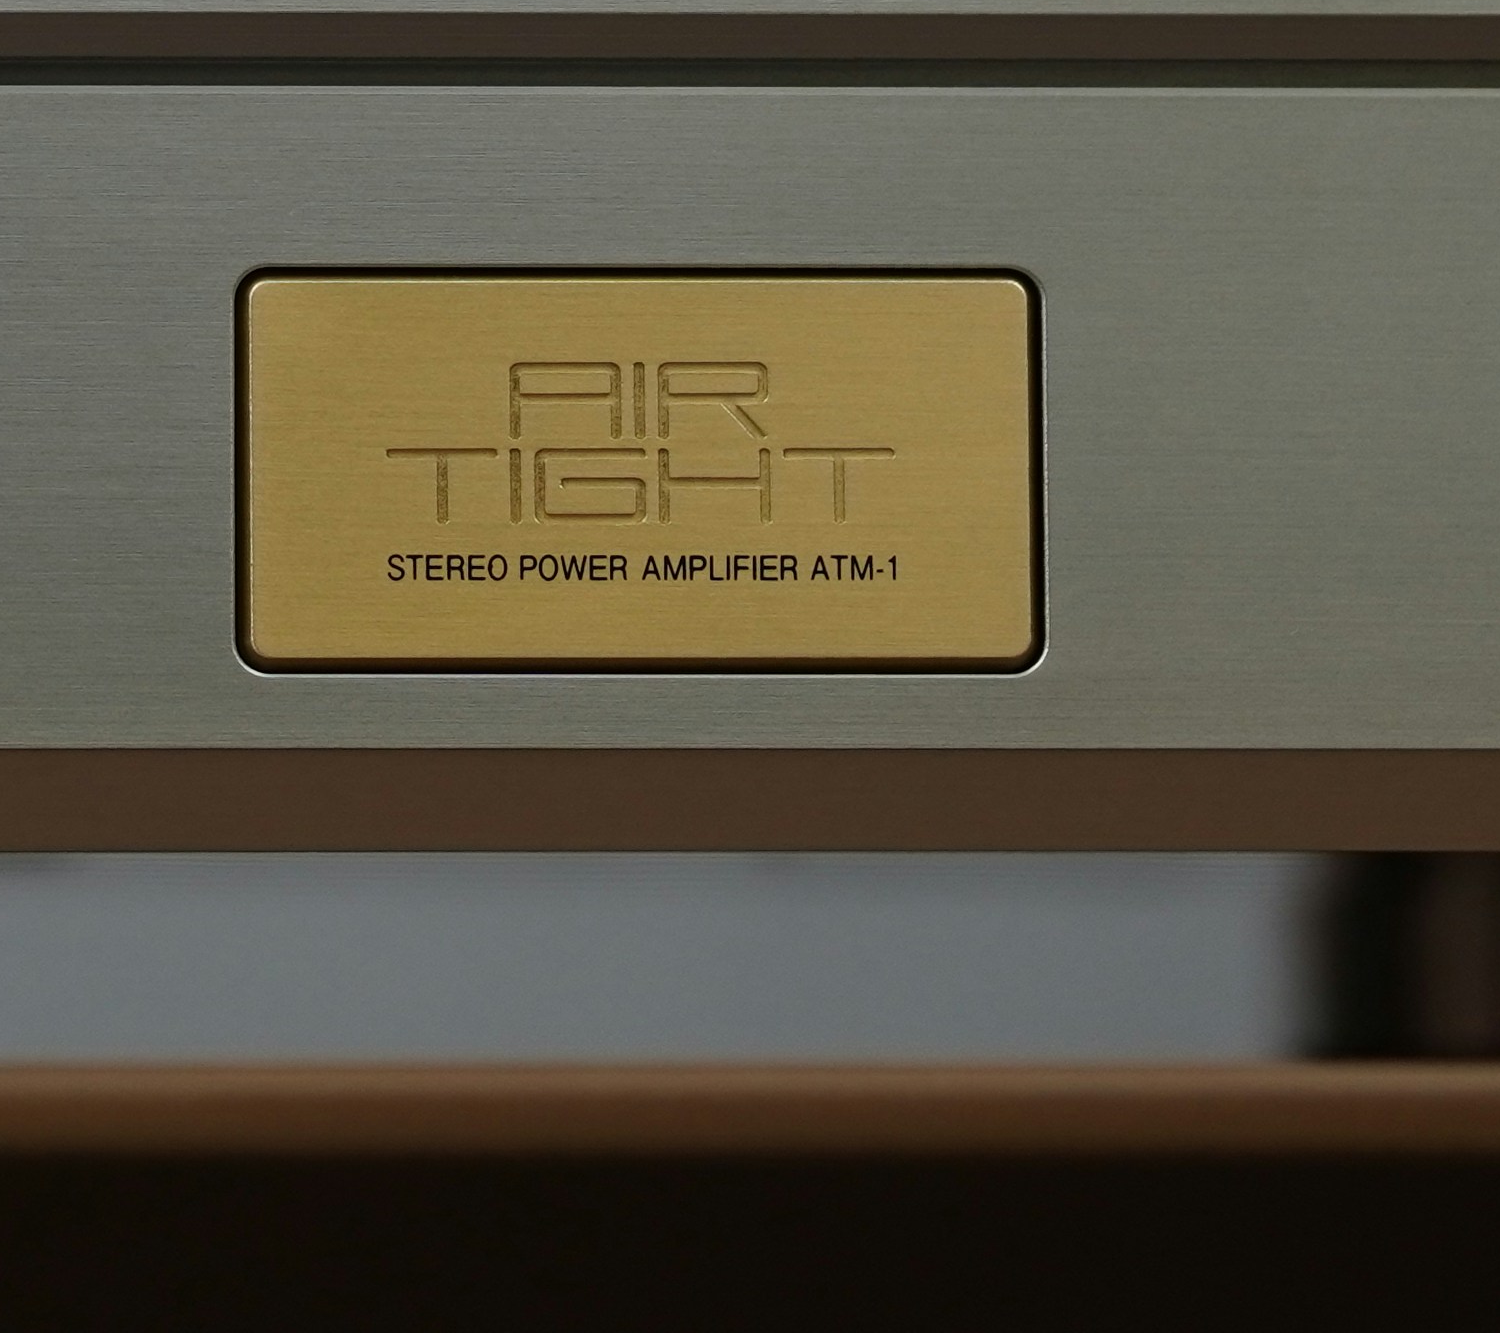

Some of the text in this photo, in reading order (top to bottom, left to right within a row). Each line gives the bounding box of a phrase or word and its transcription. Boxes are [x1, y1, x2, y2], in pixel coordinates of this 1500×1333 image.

[508, 361, 769, 440] AIR
[386, 447, 896, 525] TIGHT
[387, 554, 899, 583] STEREO POWER AMPLIFIER ATM-1
